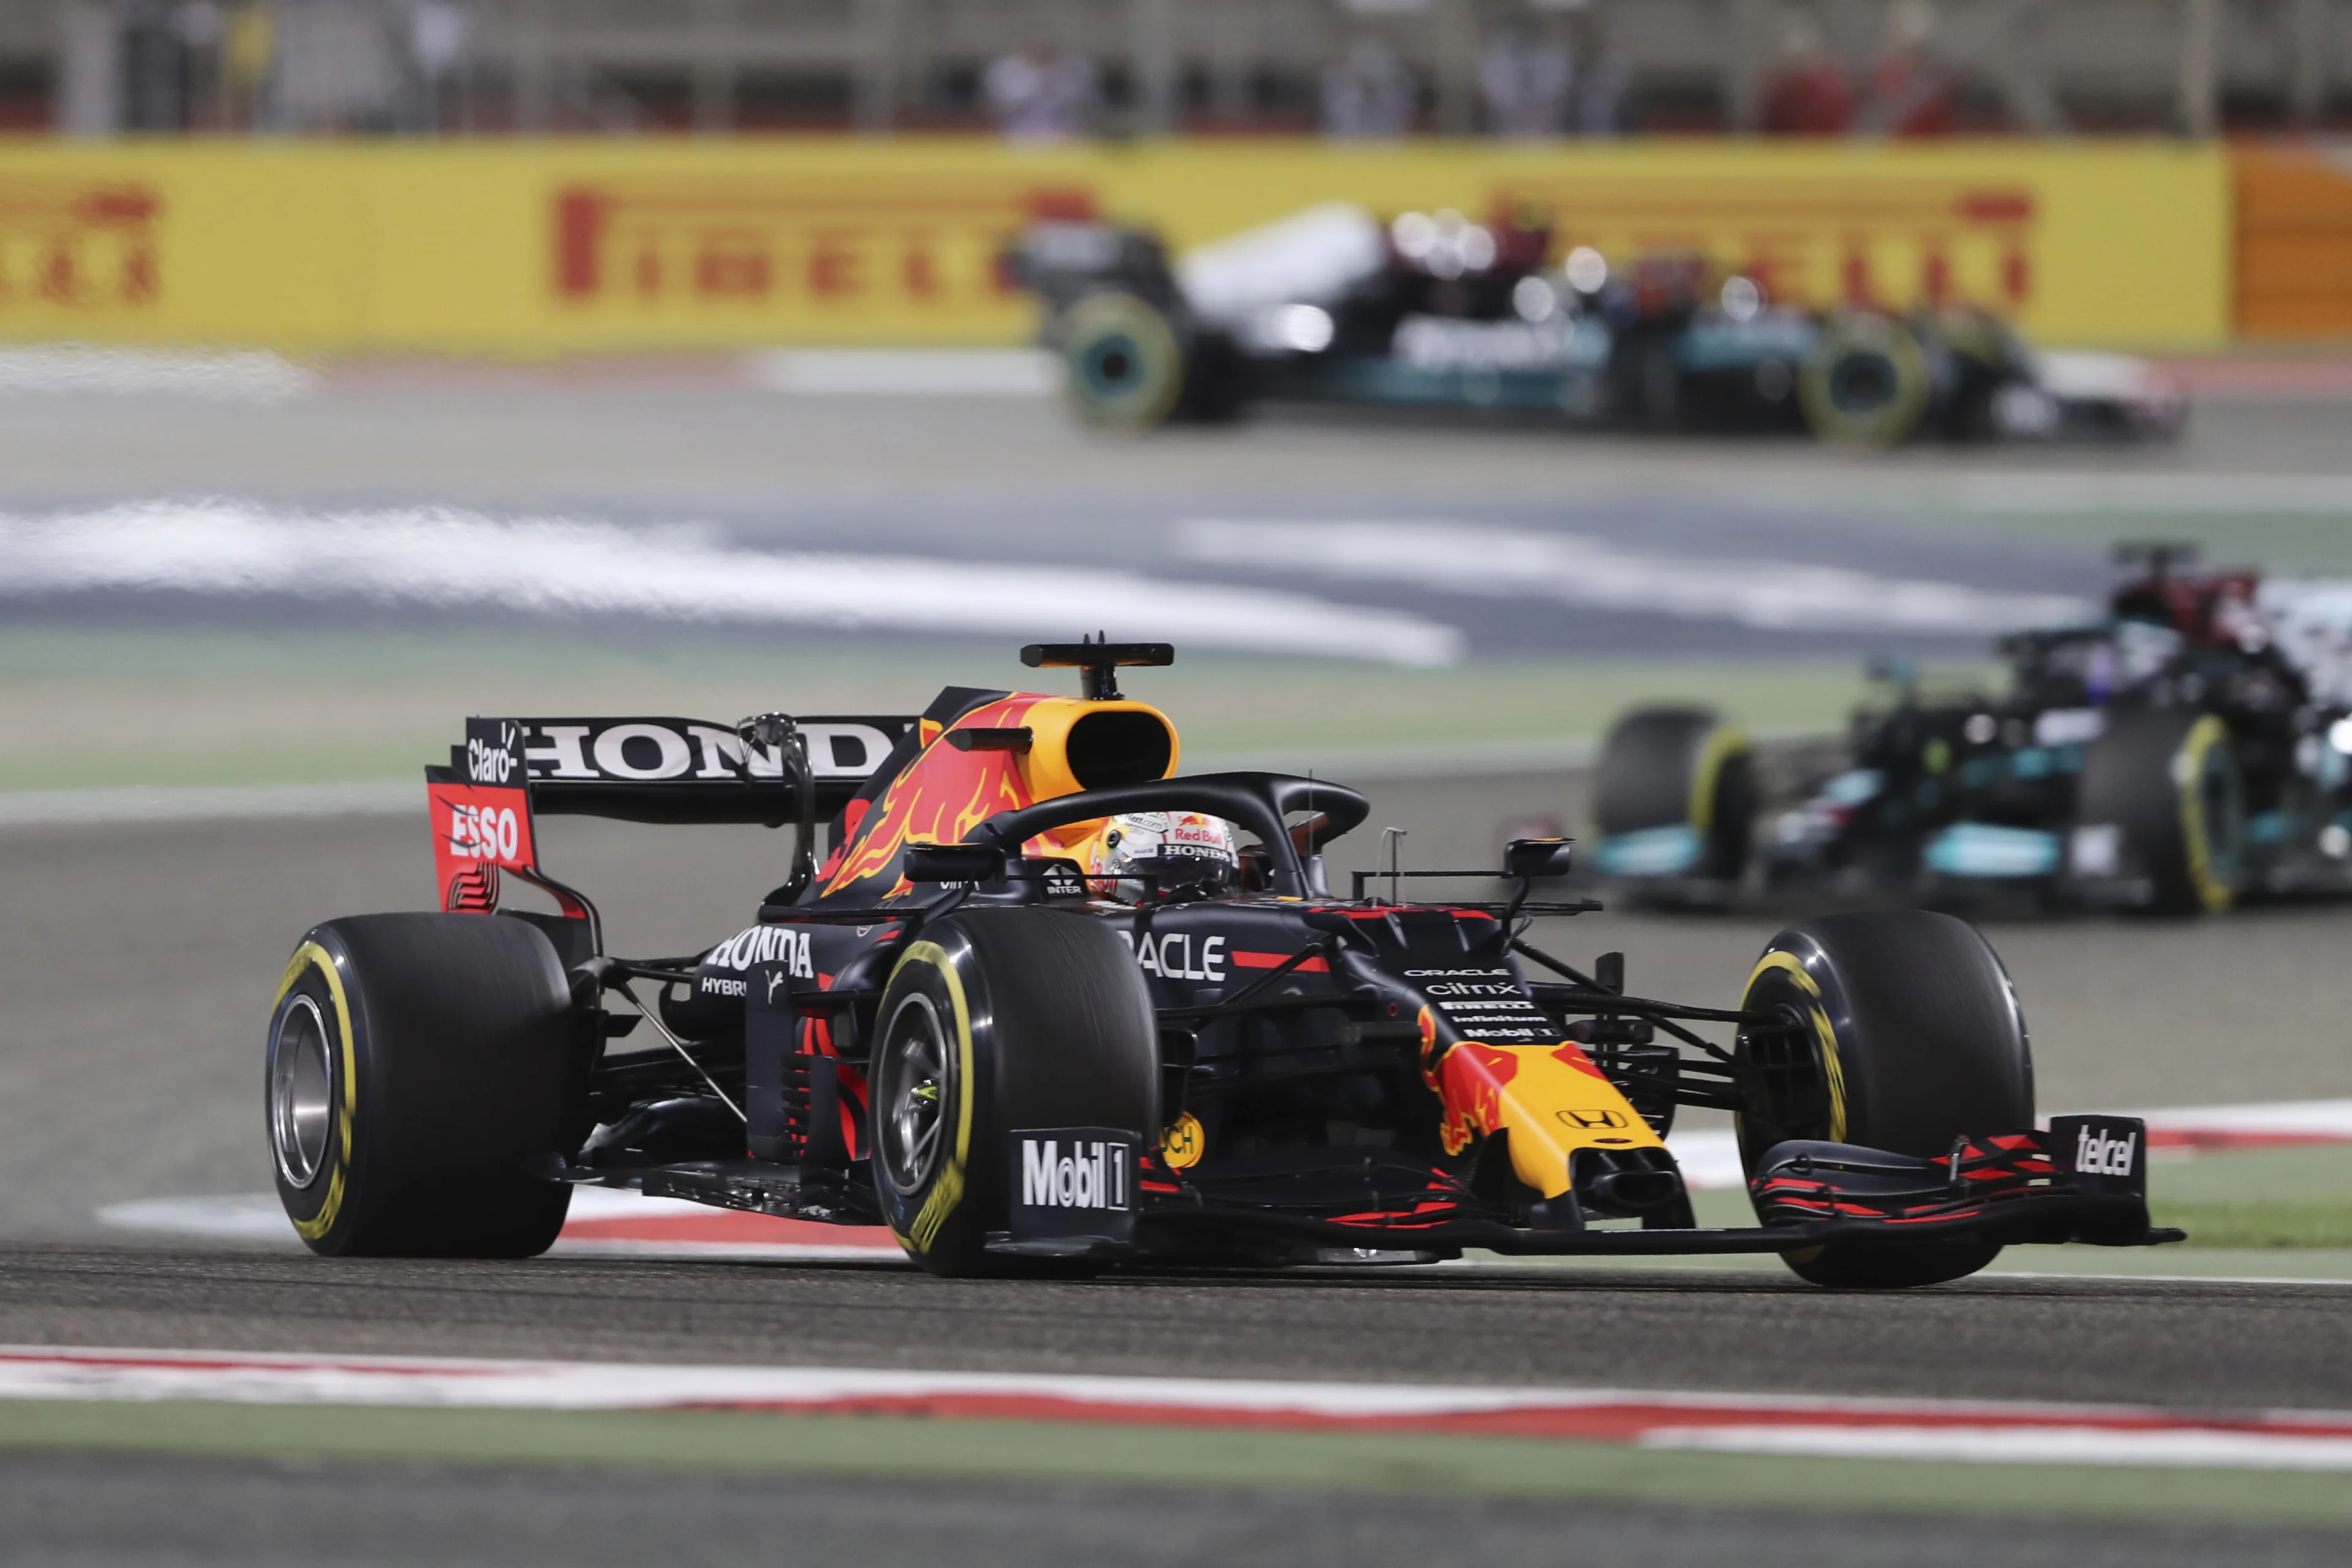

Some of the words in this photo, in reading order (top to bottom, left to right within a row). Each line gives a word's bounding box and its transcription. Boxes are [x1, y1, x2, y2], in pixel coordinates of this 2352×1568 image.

[467, 737, 510, 783] Claro
[521, 723, 915, 779] HOND
[450, 804, 519, 861] ESSO
[1164, 845, 1231, 862] HONDA
[1175, 828, 1200, 840] Red
[706, 924, 814, 979] HONDA
[1116, 930, 1226, 981] ACLE
[1438, 1000, 1535, 1010] PIRELLI
[1463, 1028, 1536, 1038] Mobil
[1022, 1139, 1106, 1208] Mobil
[2075, 1124, 2137, 1177] telcel
